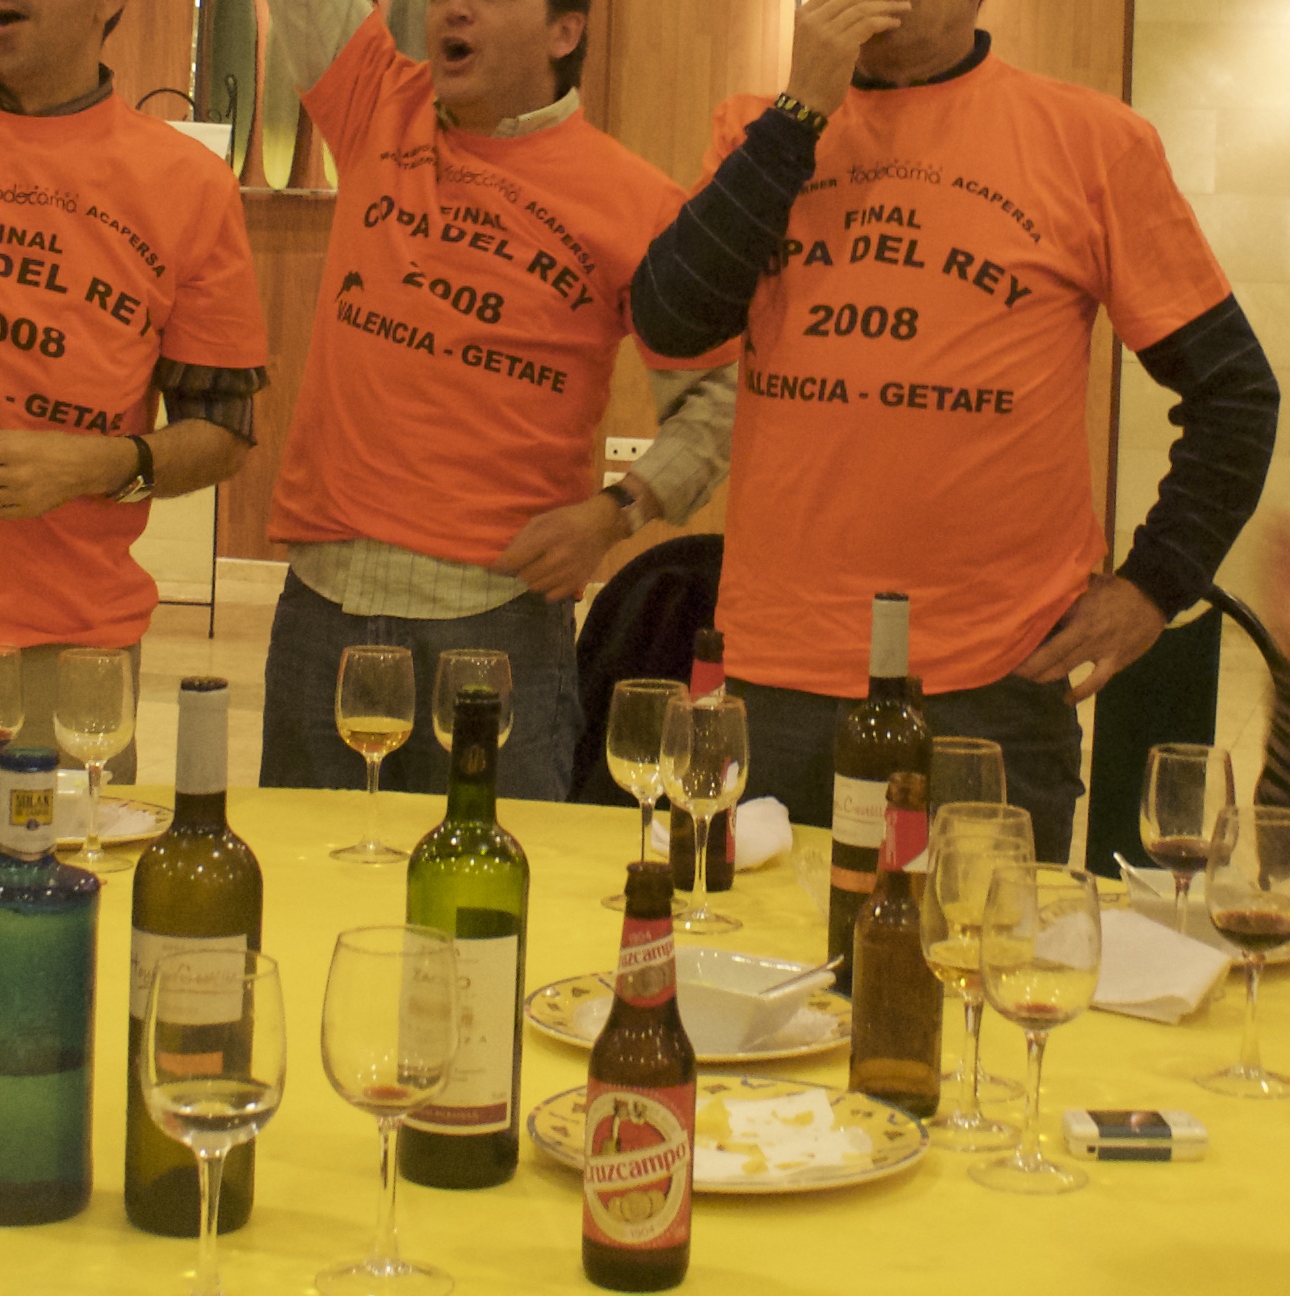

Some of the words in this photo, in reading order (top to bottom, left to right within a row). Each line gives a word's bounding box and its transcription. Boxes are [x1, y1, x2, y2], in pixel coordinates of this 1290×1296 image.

[85, 205, 166, 279] ACAPERSA
[440, 205, 508, 232] FINAL
[524, 200, 596, 275] ACAPERSA
[844, 205, 921, 230] FINAL
[951, 176, 1041, 244] ACAPERSA
[364, 195, 430, 239] COPA
[440, 223, 514, 261] DEL
[526, 249, 594, 312] REY
[849, 233, 925, 269] DEL
[941, 246, 1033, 311] REY
[401, 261, 505, 326] 2008
[803, 304, 919, 341] 2008
[335, 299, 436, 356] VALENCIA
[461, 344, 568, 394] GETAFE
[879, 381, 1014, 414] GETAFE
